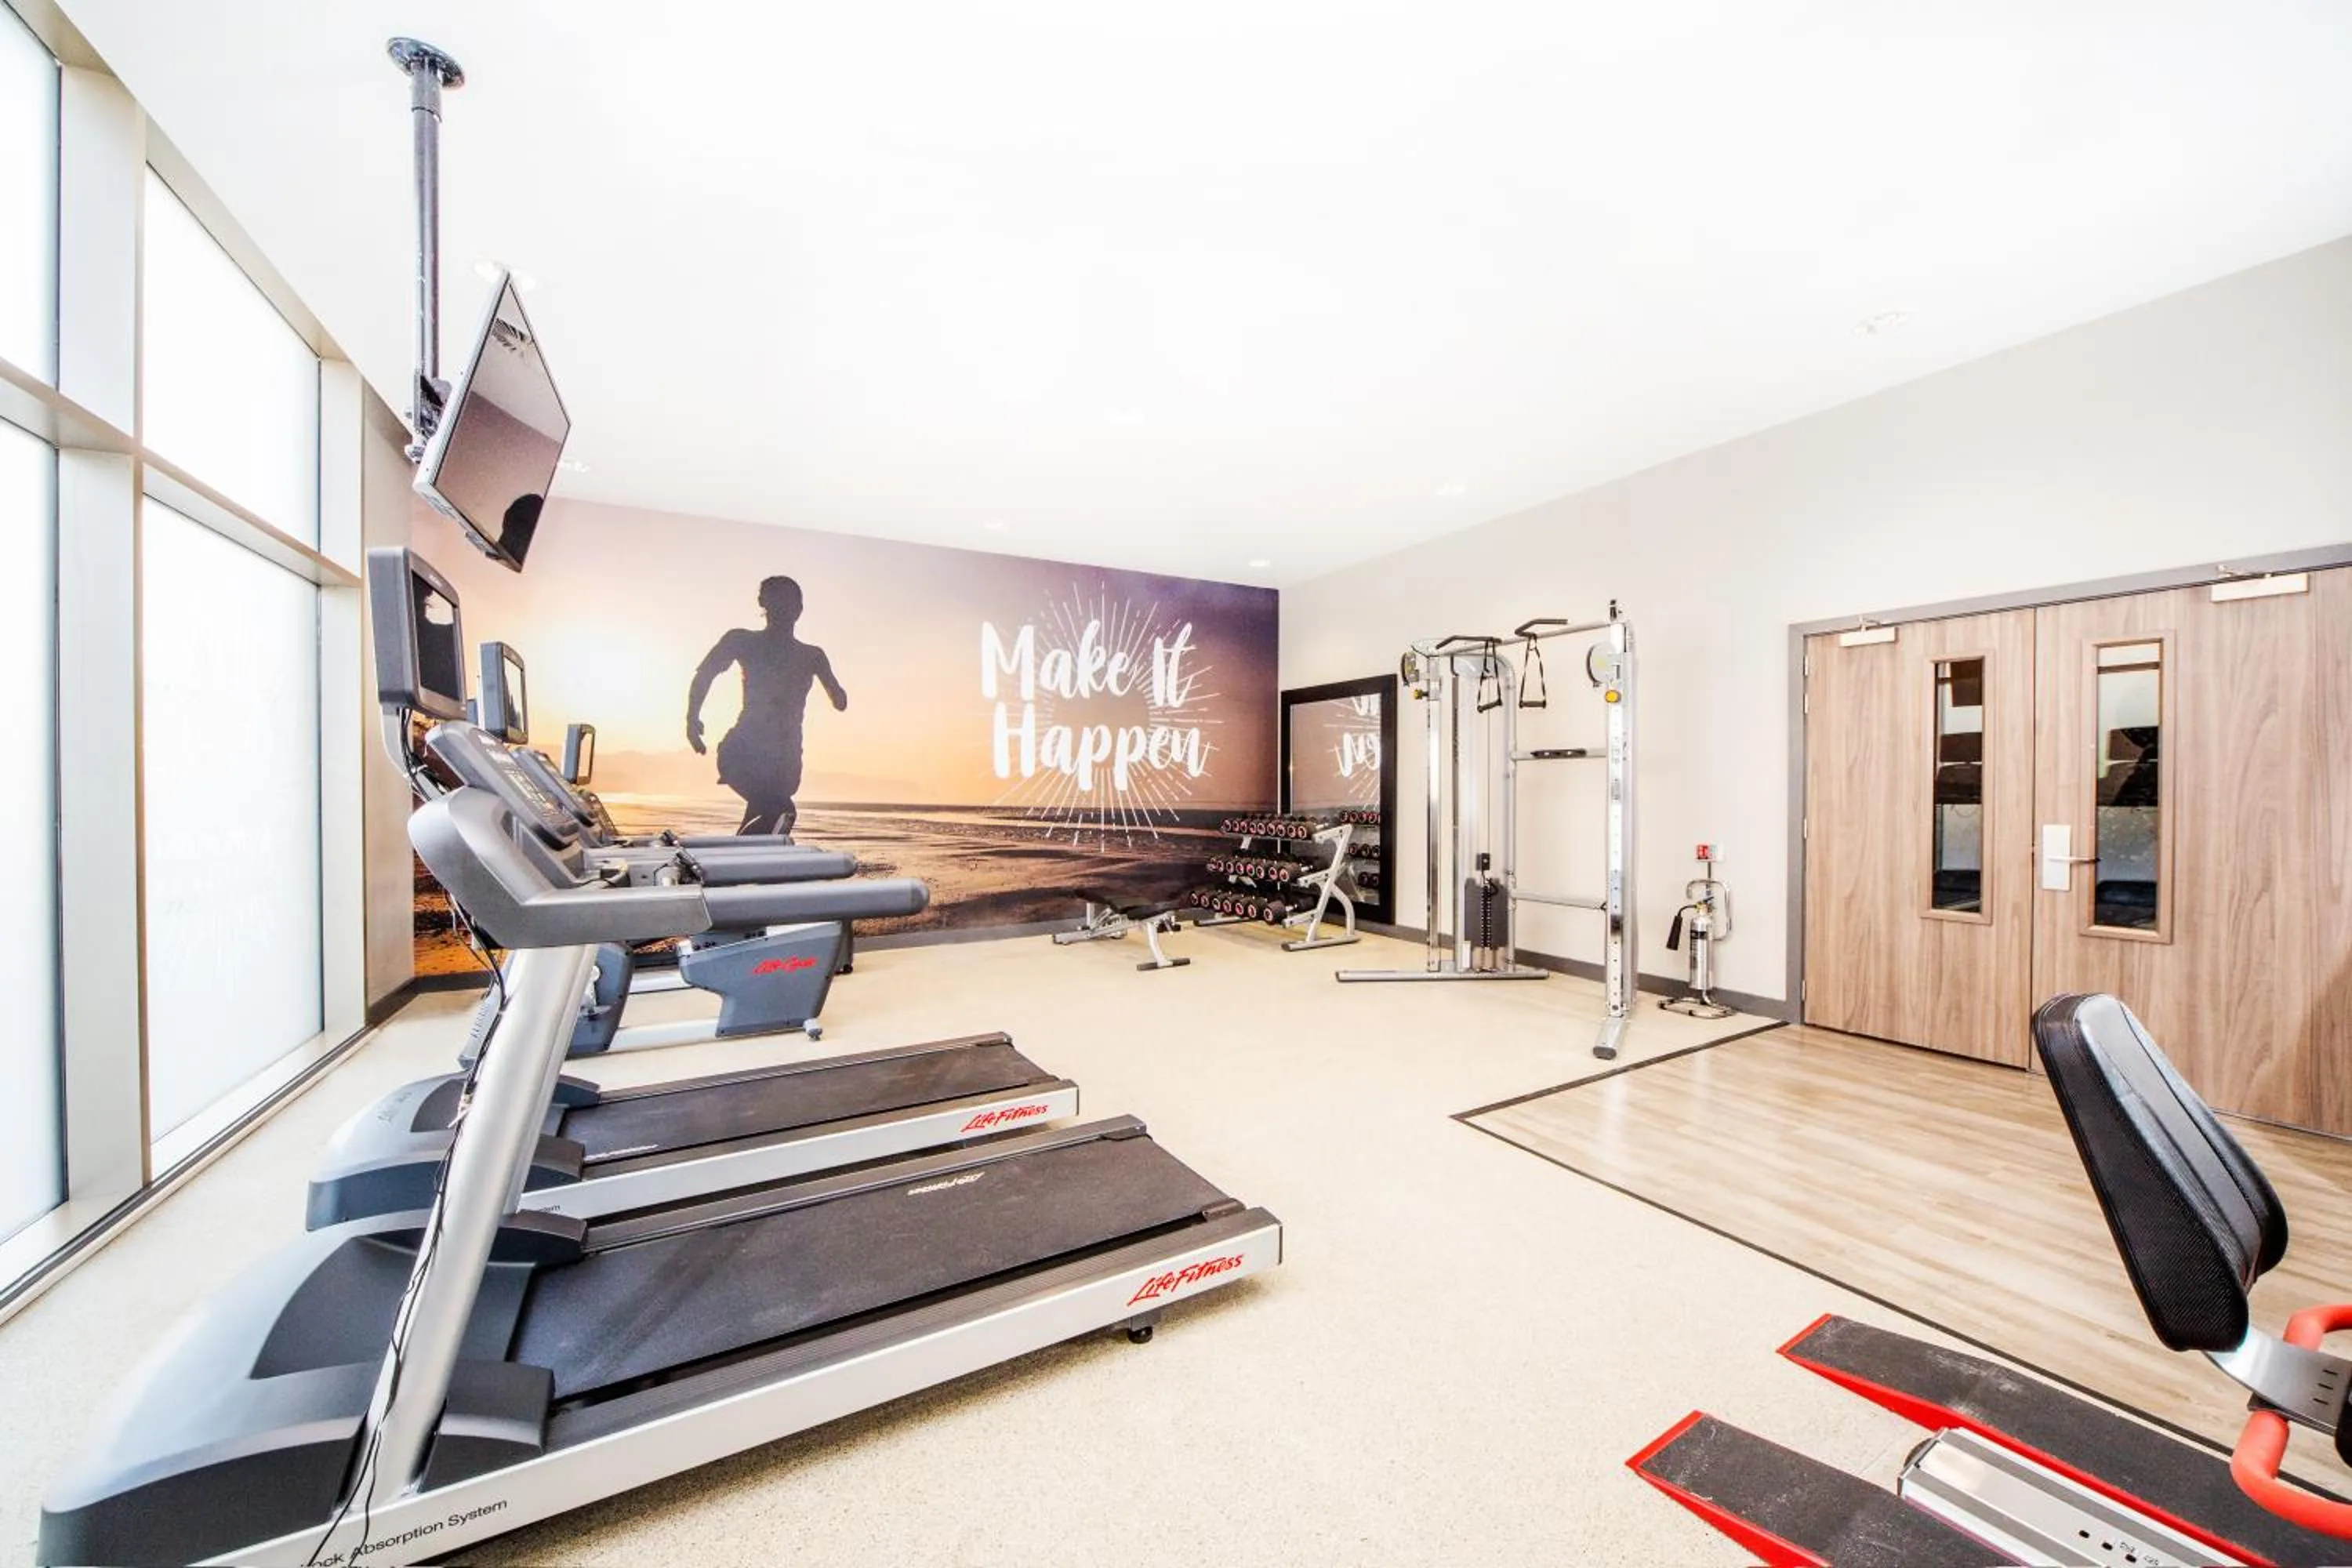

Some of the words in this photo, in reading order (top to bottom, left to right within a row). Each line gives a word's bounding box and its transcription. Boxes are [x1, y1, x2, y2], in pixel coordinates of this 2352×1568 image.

[981, 619, 1138, 702] Make
[1152, 622, 1196, 708] It
[993, 702, 1208, 791] Happen
[350, 1522, 443, 1559] Absorption
[448, 1499, 507, 1527] System
